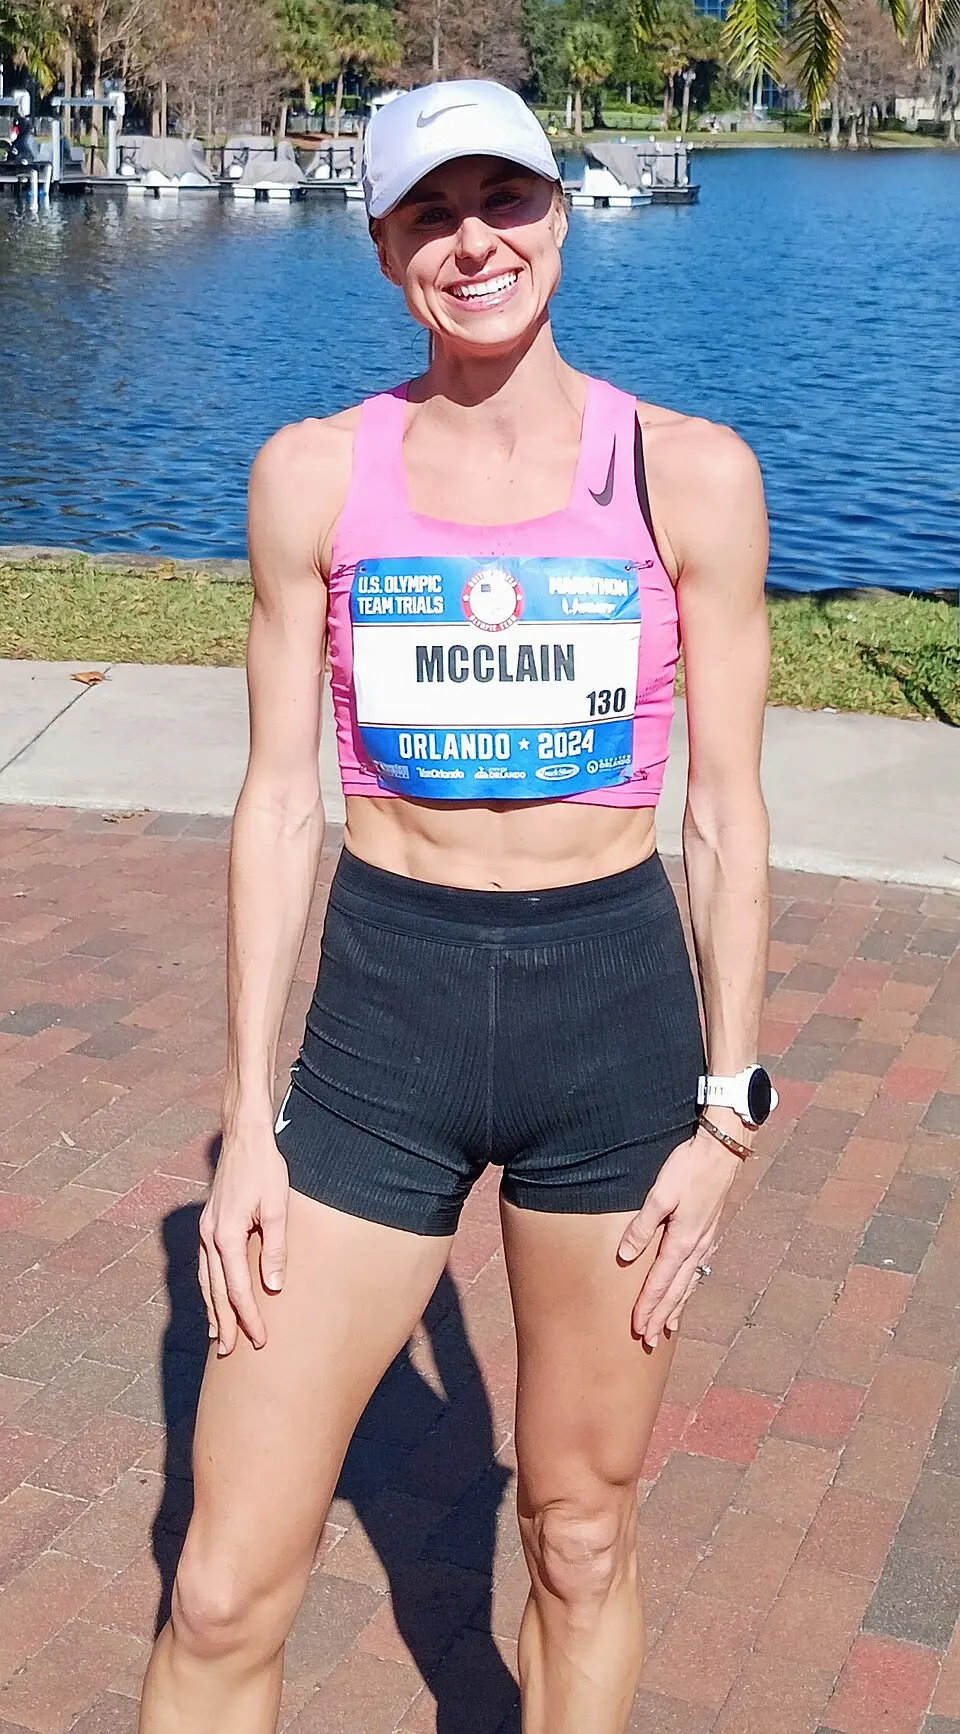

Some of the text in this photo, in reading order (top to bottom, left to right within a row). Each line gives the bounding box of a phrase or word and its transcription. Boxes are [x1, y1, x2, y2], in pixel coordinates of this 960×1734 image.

[358, 575, 443, 594] U.S. OLYMPIC
[357, 596, 444, 615] TEAM TRIALS
[416, 644, 575, 683] MCCLAIN
[586, 687, 627, 716] 130
[398, 729, 595, 760] ORLANDO 2024
